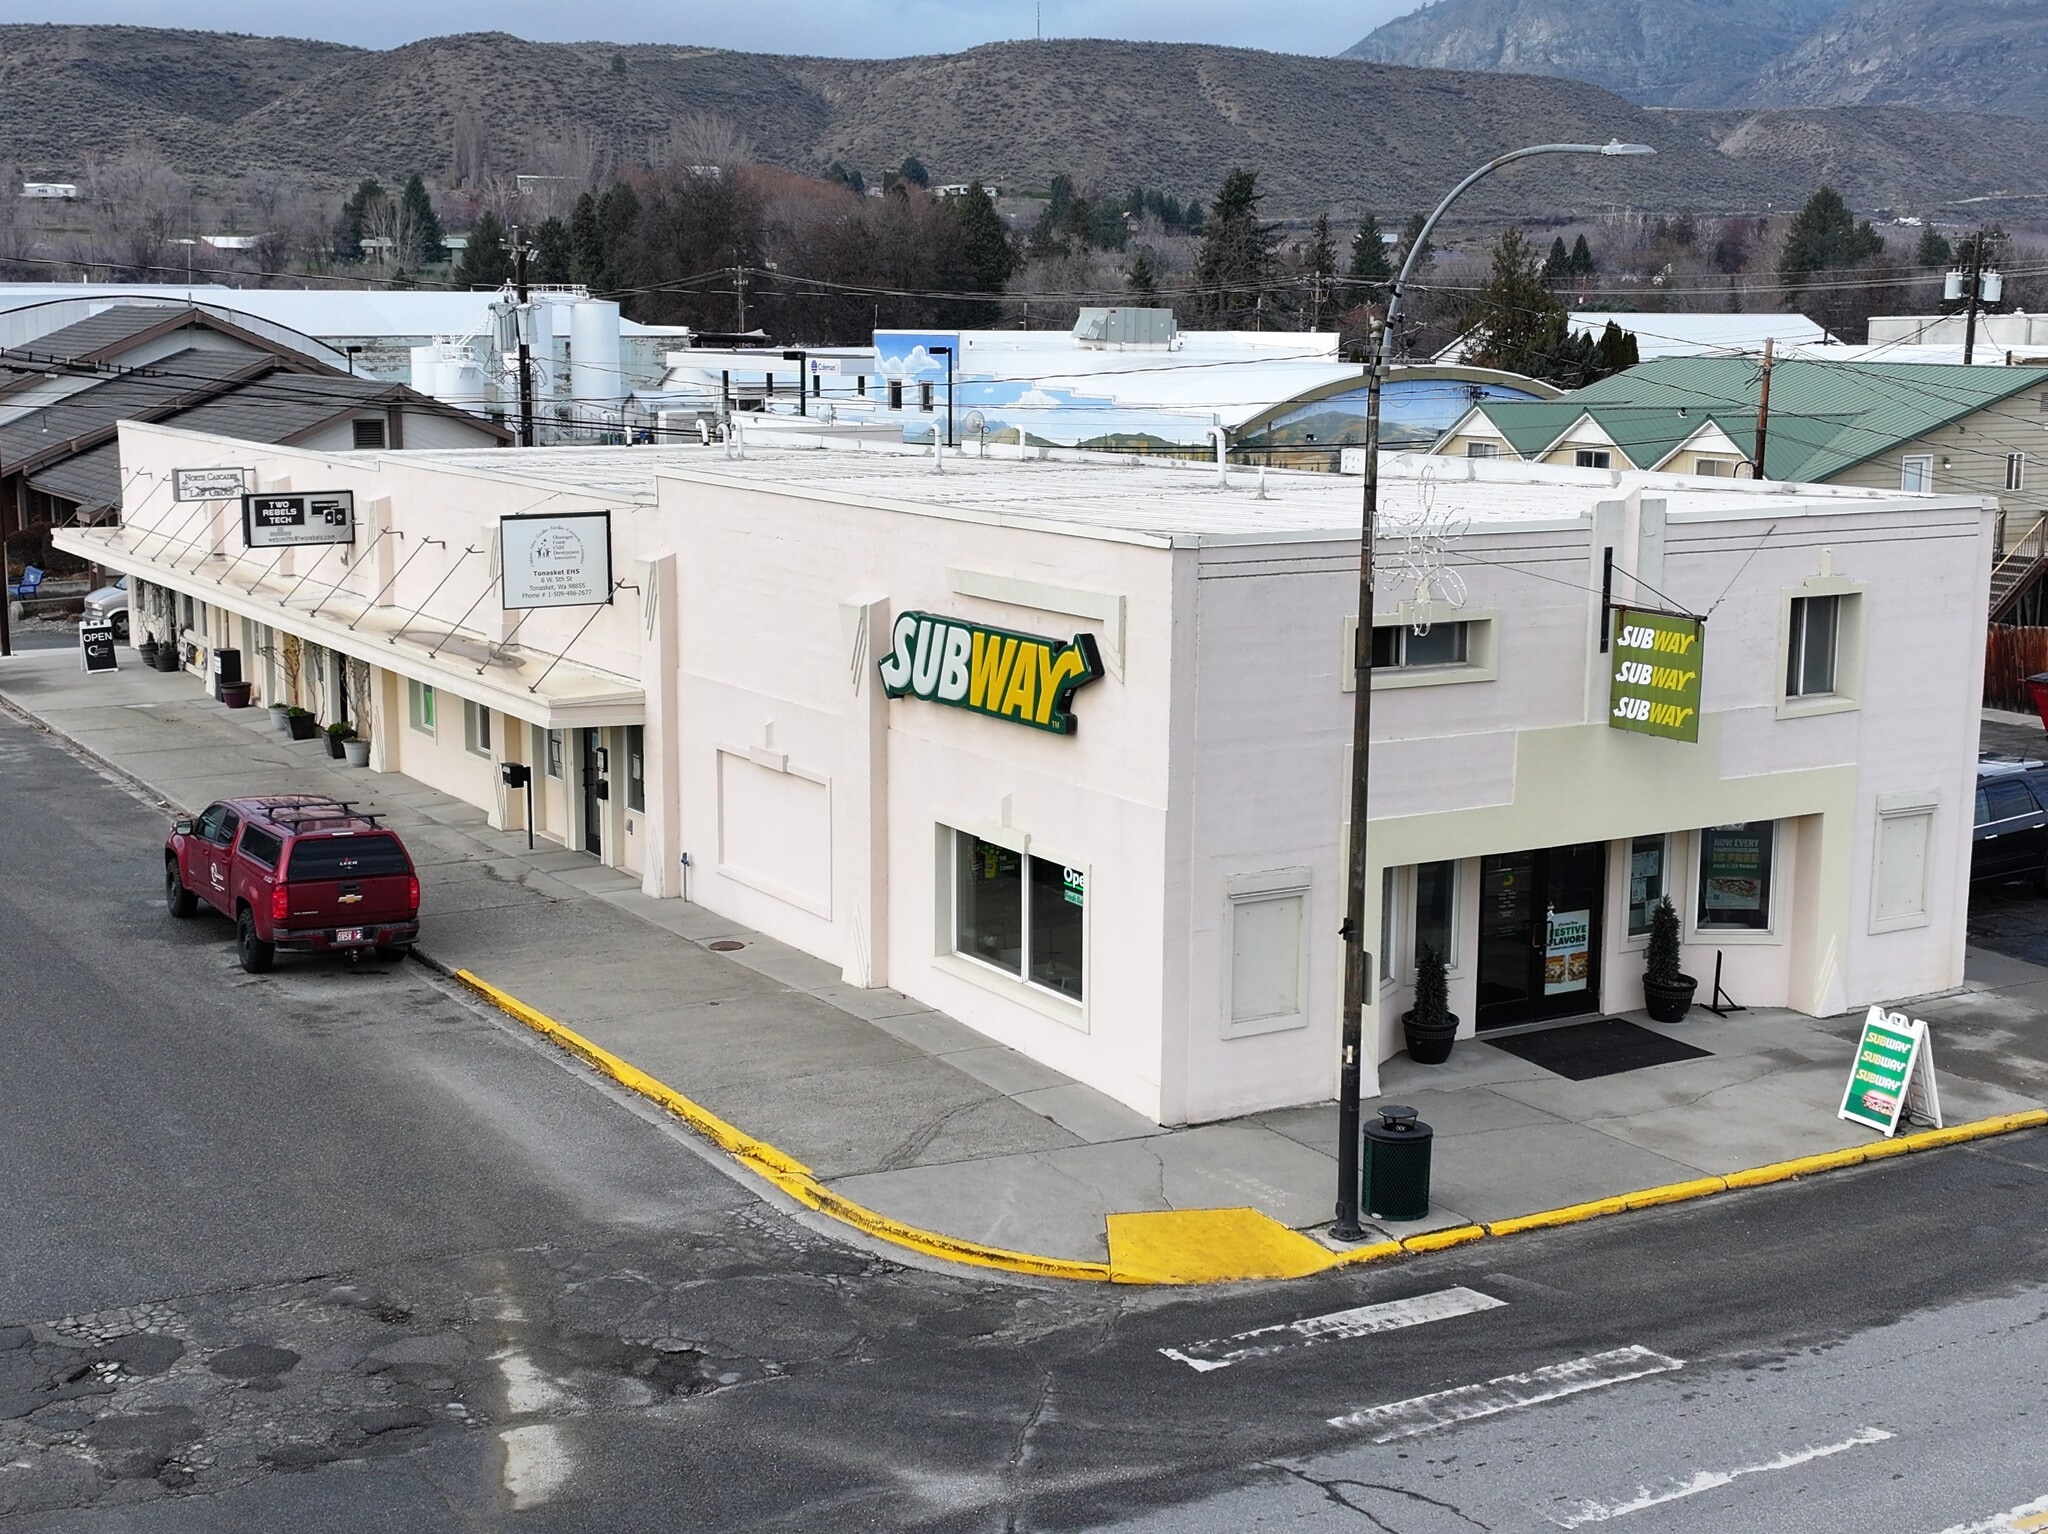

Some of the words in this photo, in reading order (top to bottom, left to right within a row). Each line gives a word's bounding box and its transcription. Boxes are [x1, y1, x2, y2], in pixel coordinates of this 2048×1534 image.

[189, 489, 206, 498] LAW
[268, 501, 290, 509] TWO
[262, 508, 297, 517] REBELS
[268, 516, 292, 525] TECH
[533, 569, 564, 577] Tonasket
[83, 632, 113, 642] OPEN
[1617, 625, 1696, 655] SUBWAY
[879, 616, 1085, 725] SUBWAY
[1615, 661, 1697, 691] SUBWAY
[1612, 696, 1695, 728] SUBWAY
[1713, 838, 1733, 847] NOW
[1734, 838, 1760, 847] EVERY
[1713, 853, 1726, 863] IS
[1727, 853, 1760, 863] FREE
[1064, 867, 1084, 889] Ope
[1553, 924, 1587, 938] ESTIVE
[1553, 934, 1587, 946] LAVORS
[1866, 1032, 1911, 1054] SUBWAY
[1861, 1051, 1907, 1073] SUBWAY
[1855, 1069, 1902, 1091] SUBWAY
